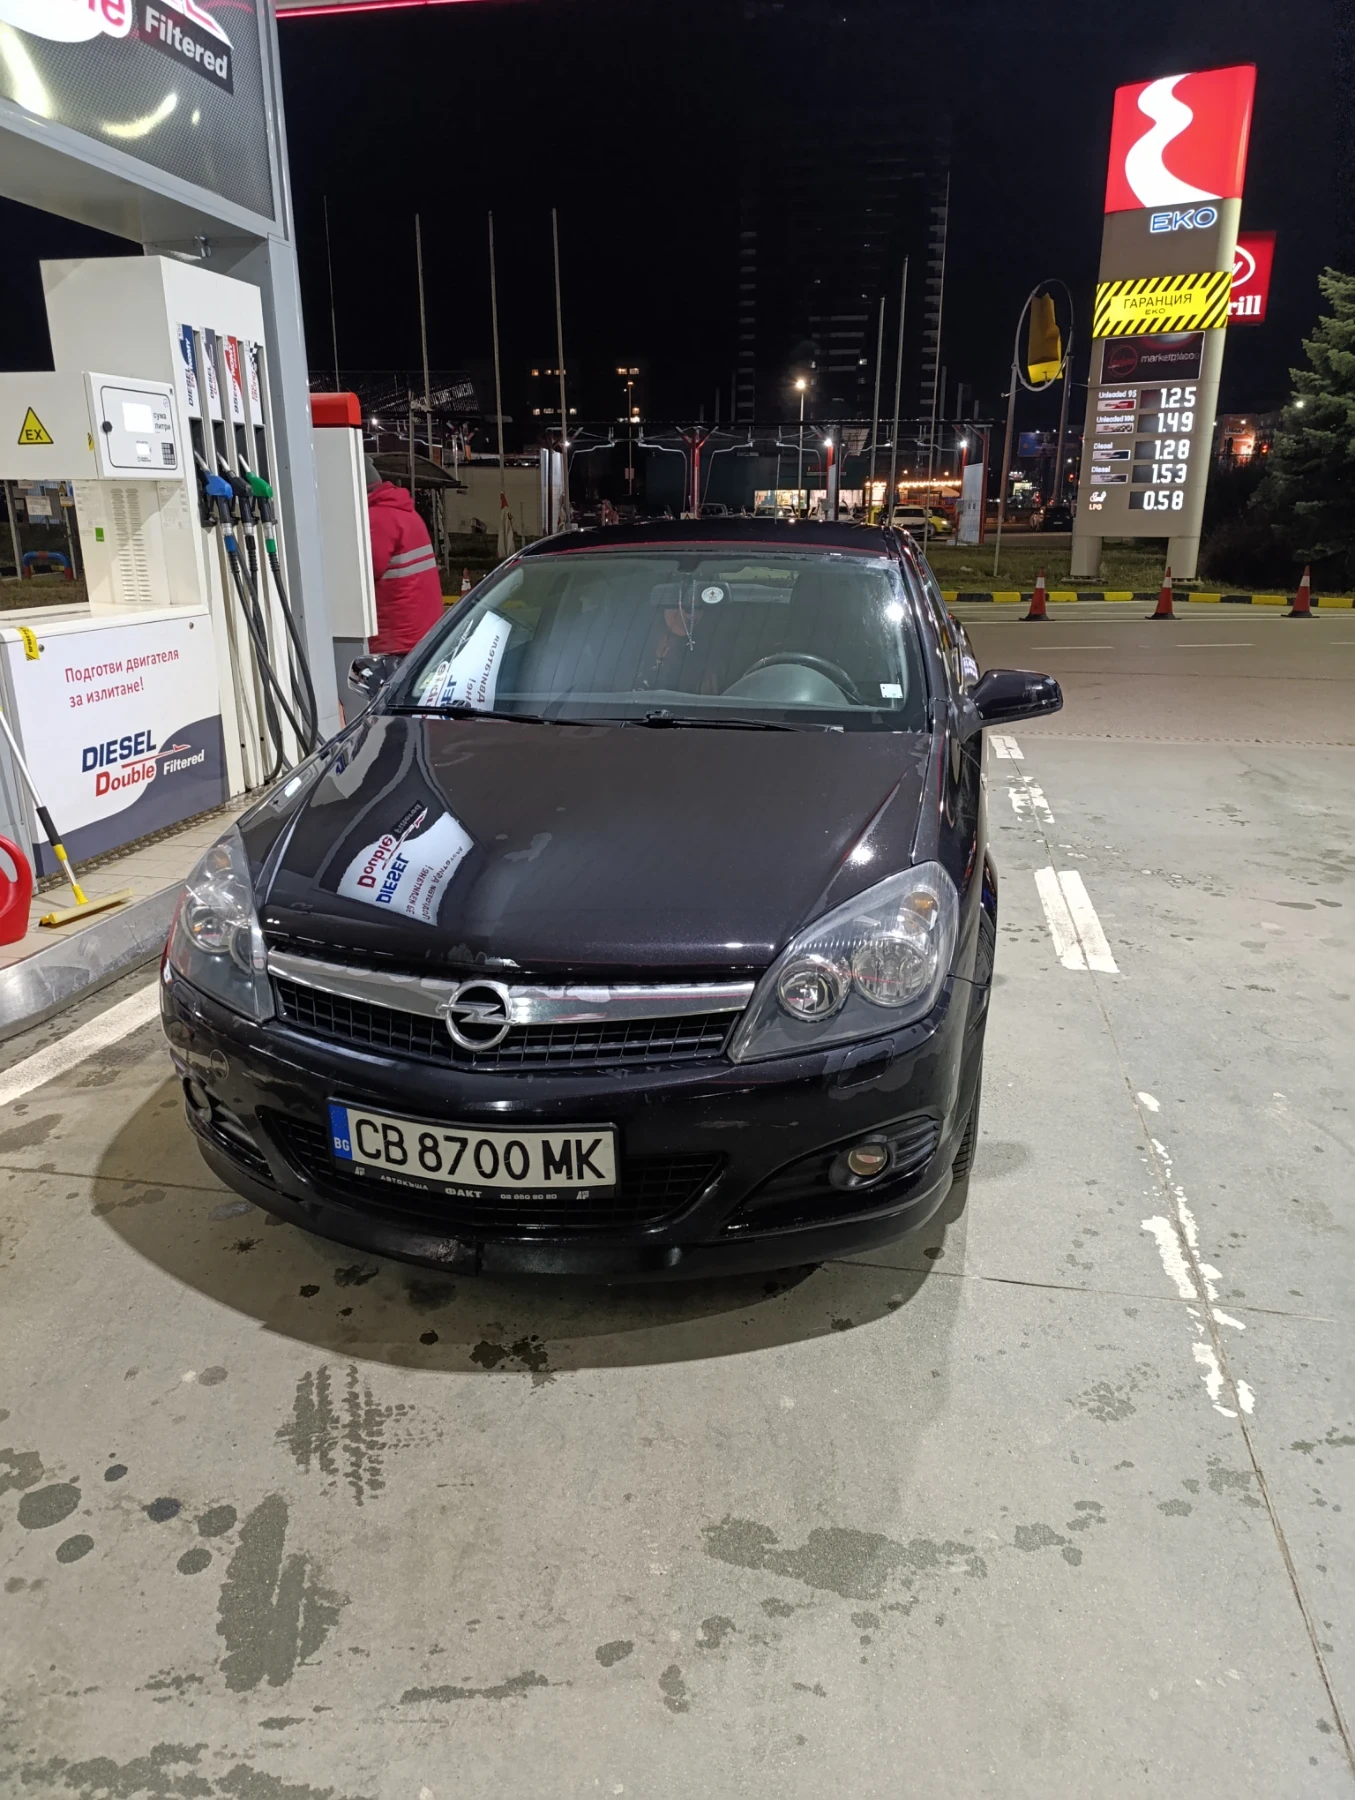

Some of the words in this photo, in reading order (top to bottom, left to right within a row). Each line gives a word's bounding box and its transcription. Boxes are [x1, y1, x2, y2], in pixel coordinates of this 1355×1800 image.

[145, 5, 228, 80] Filtered
[1150, 207, 1217, 233] EKO
[1123, 293, 1192, 309] ГАРАНЦИЯ
[1227, 294, 1262, 316] rill
[1160, 386, 1197, 409] 1.25
[1158, 411, 1194, 433] 1.49
[25, 429, 43, 441] EX
[1093, 441, 1113, 449] Diesel
[1154, 439, 1190, 460] 1.28
[1091, 465, 1111, 473] Diesel
[1152, 463, 1188, 484] 1.53
[1143, 490, 1184, 511] 0.58
[65, 660, 123, 683] Подготви
[126, 649, 179, 673] двигателя
[69, 694, 83, 708] за
[86, 676, 144, 704] излитане!
[82, 729, 157, 773] DIESEL
[163, 749, 205, 775] Filtered
[96, 763, 155, 797] Double
[333, 1137, 350, 1152] BG
[355, 1118, 408, 1166] CB
[418, 1131, 530, 1181] 8700
[541, 1138, 606, 1181] MK
[445, 1187, 482, 1199] ФАКТ
